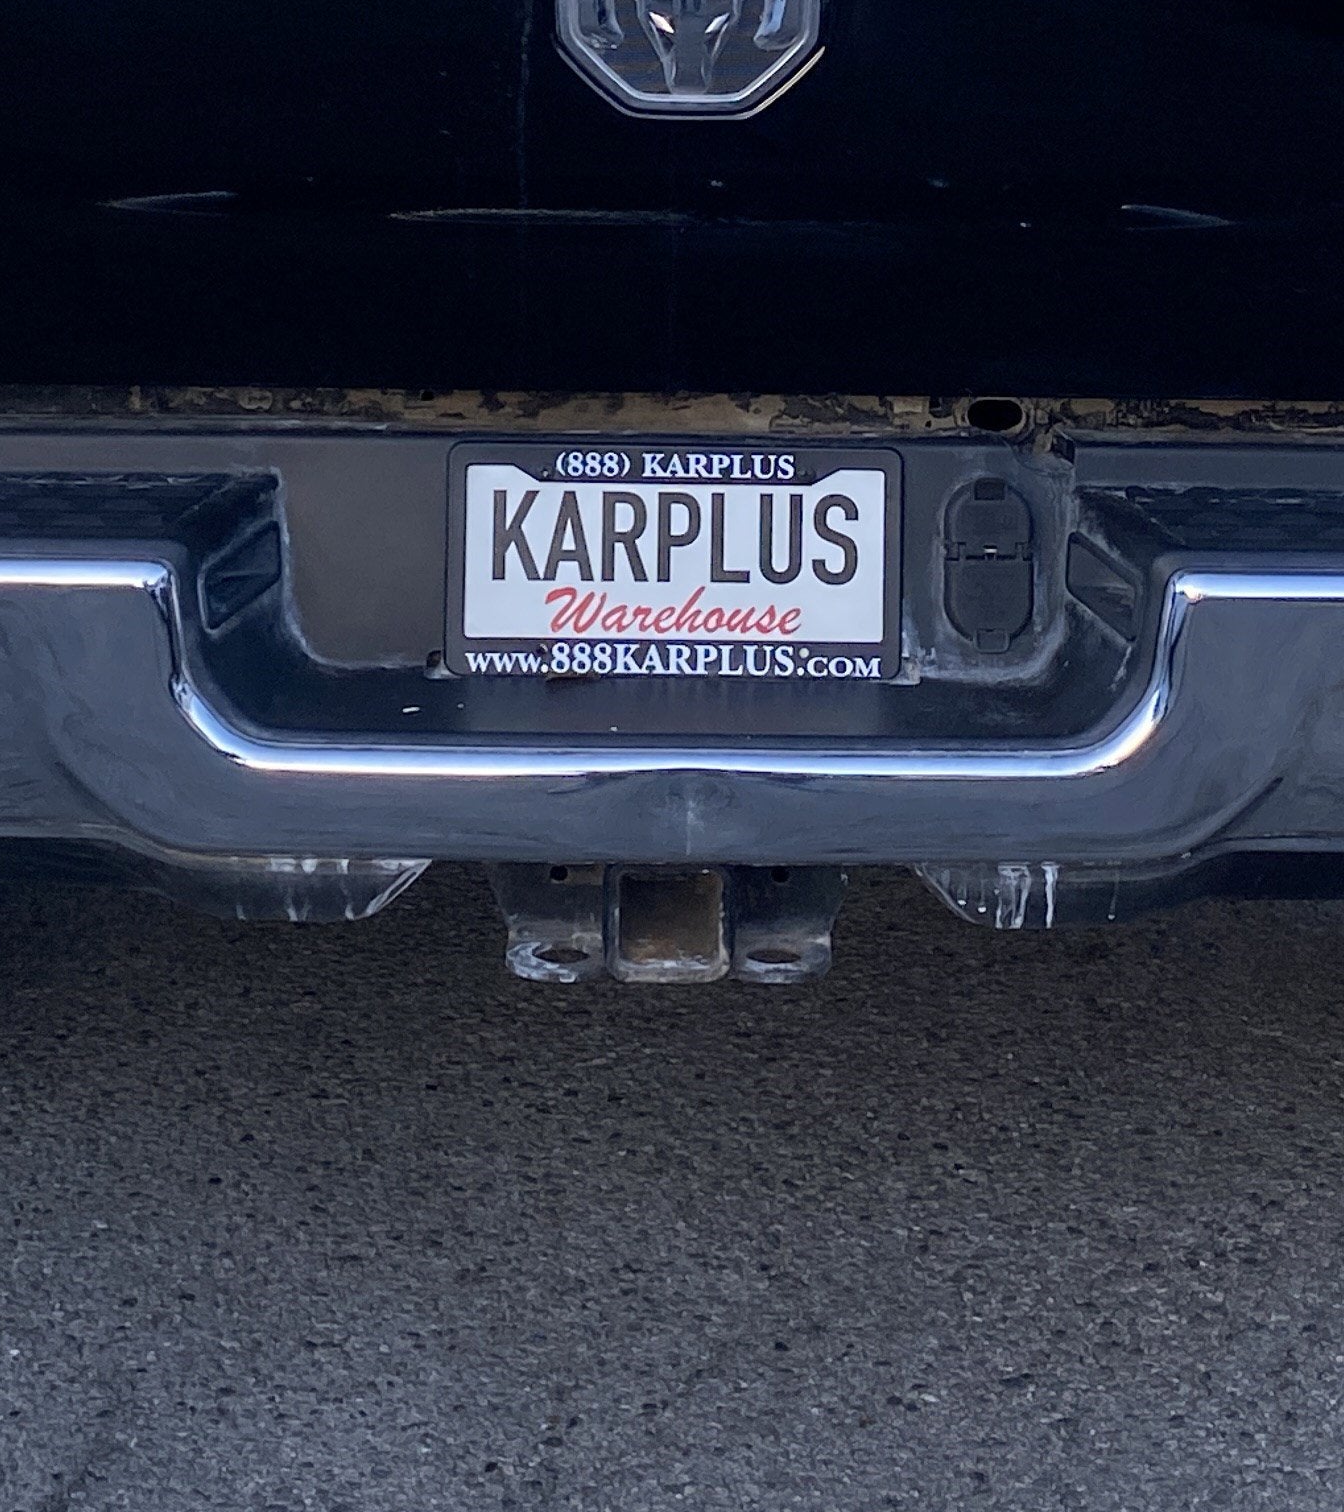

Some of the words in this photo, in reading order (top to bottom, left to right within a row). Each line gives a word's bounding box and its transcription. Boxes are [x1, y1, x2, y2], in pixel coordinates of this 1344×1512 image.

[555, 451, 631, 478] (888)
[642, 453, 795, 480] KARPLUS
[492, 489, 859, 585] KARPLUS
[544, 586, 802, 635] Warehouse
